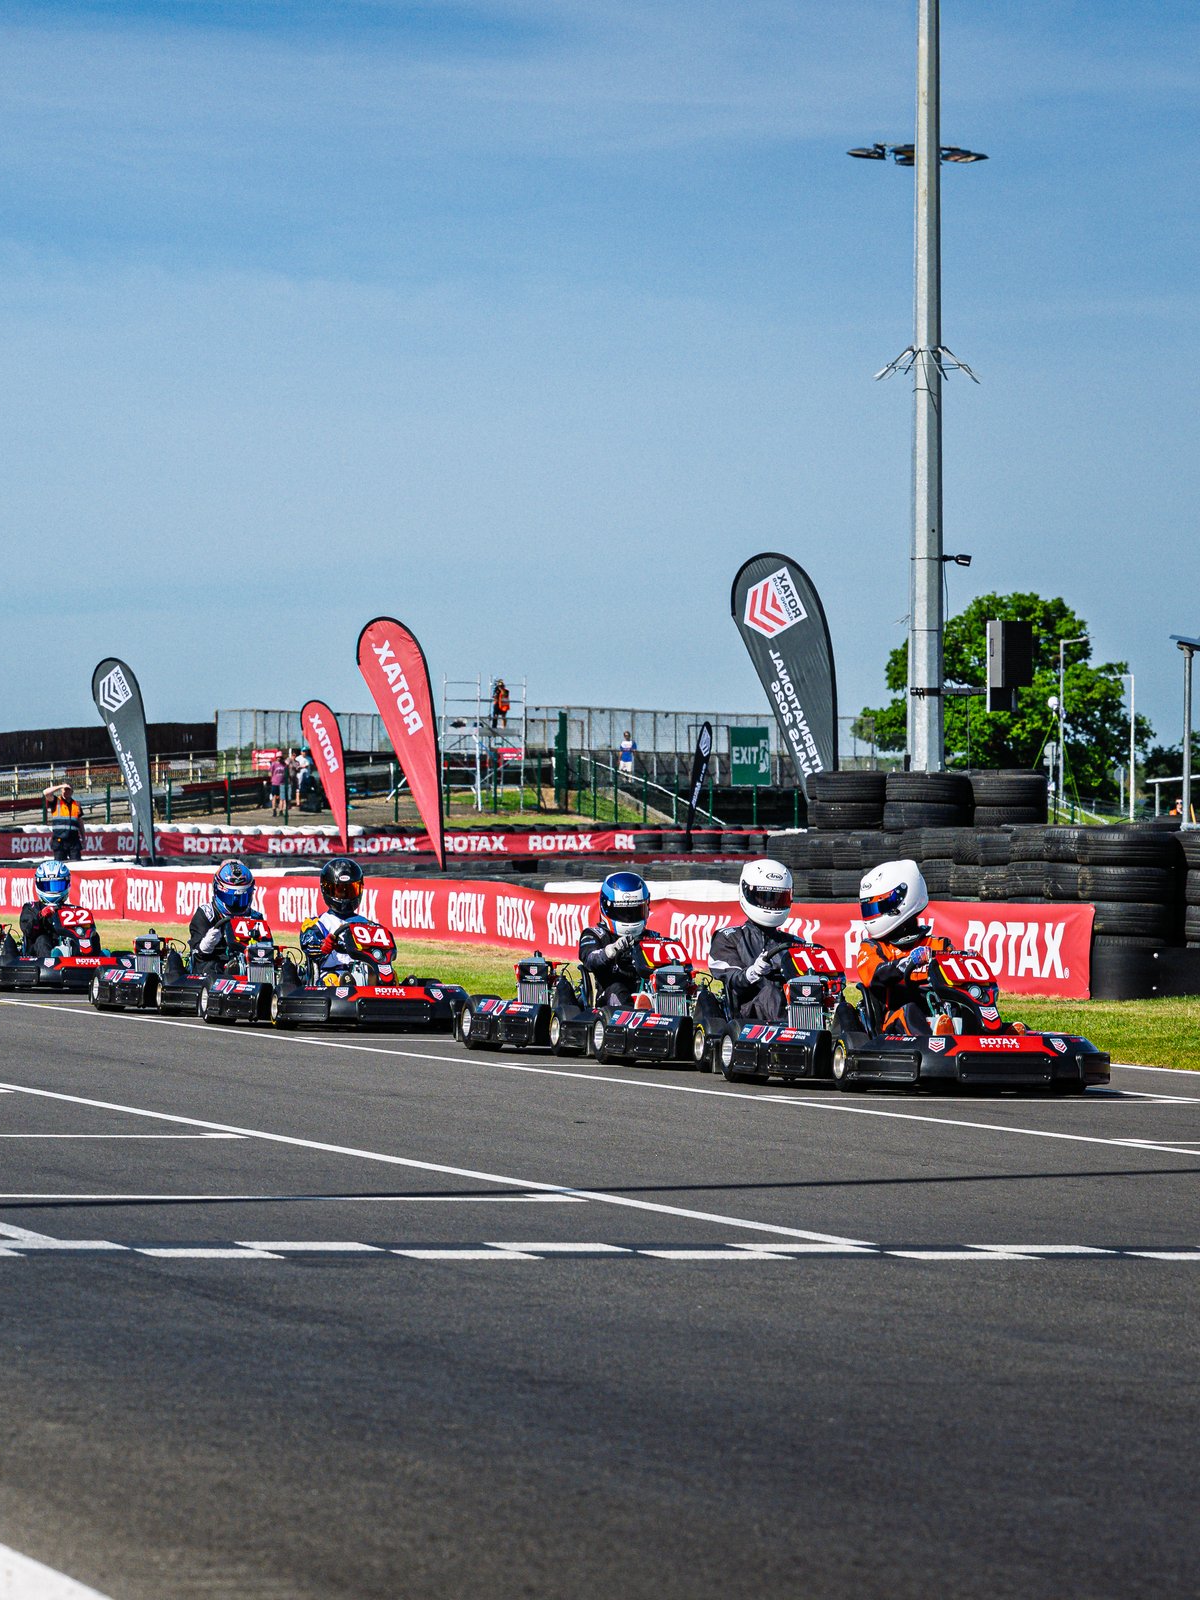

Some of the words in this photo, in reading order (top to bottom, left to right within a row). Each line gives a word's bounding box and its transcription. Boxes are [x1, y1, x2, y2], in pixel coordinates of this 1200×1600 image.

[732, 746, 759, 764] EXIT
[12, 837, 53, 853] ROTAX
[183, 837, 245, 853] ROTAX
[268, 838, 331, 853] ROTAX
[353, 837, 417, 853] ROTAX
[444, 835, 507, 851] ROTAX
[528, 834, 593, 850] ROTAX
[80, 879, 114, 910] ROTAX
[127, 878, 164, 913] ROTAX
[278, 887, 318, 923] ROTAX
[392, 890, 435, 929] ROTAX
[448, 892, 486, 934] ROTAX
[61, 909, 91, 926] 22
[496, 896, 536, 942] ROTAX
[353, 926, 390, 946] 94
[642, 943, 687, 963] 70
[794, 950, 837, 971] 11
[942, 957, 990, 980] 10
[979, 1037, 1018, 1045] ROTAX
